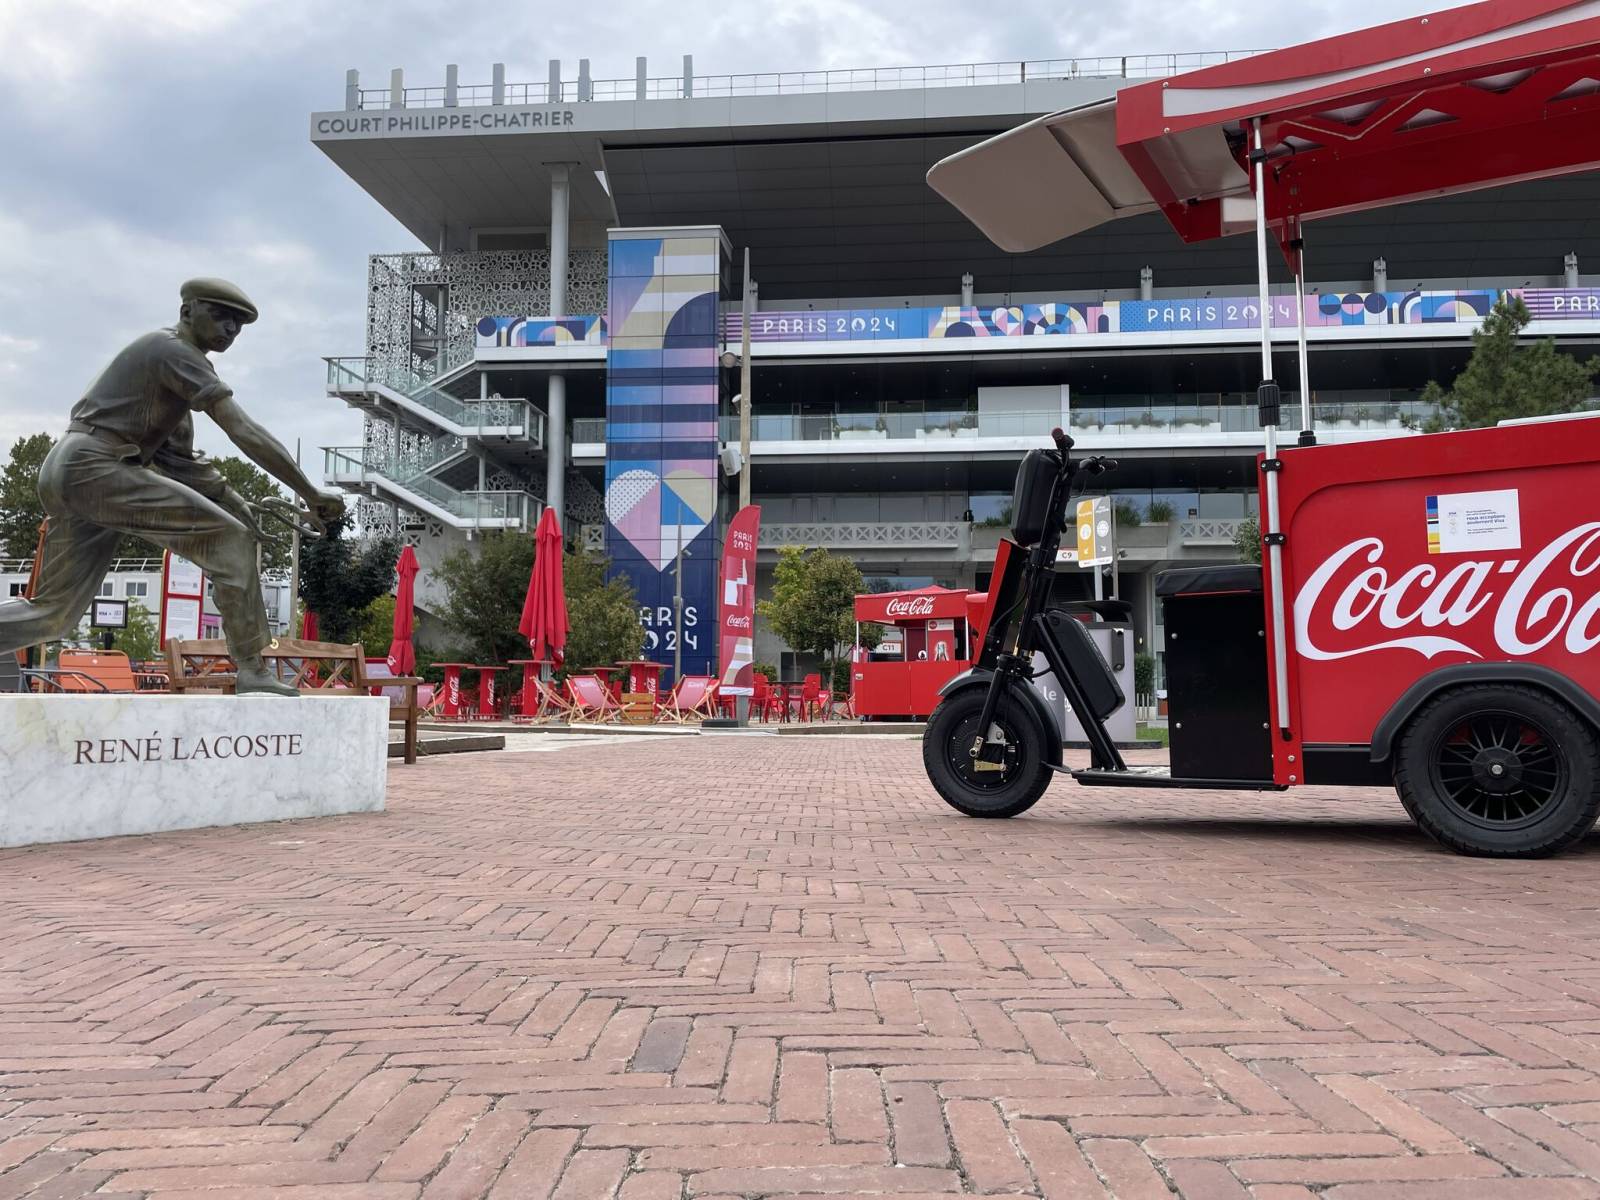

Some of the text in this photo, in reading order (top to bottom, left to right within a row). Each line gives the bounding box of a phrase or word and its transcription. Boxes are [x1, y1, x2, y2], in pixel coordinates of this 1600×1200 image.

[317, 111, 574, 134] COURT PHILIPPE-CHATRIER
[1553, 296, 1600, 312] PAR
[837, 317, 895, 333] 2024
[639, 606, 698, 627] ARS
[886, 596, 937, 617] Coca-Cola
[640, 630, 698, 651] 024
[73, 730, 303, 765] RENÉ LACOSTE
